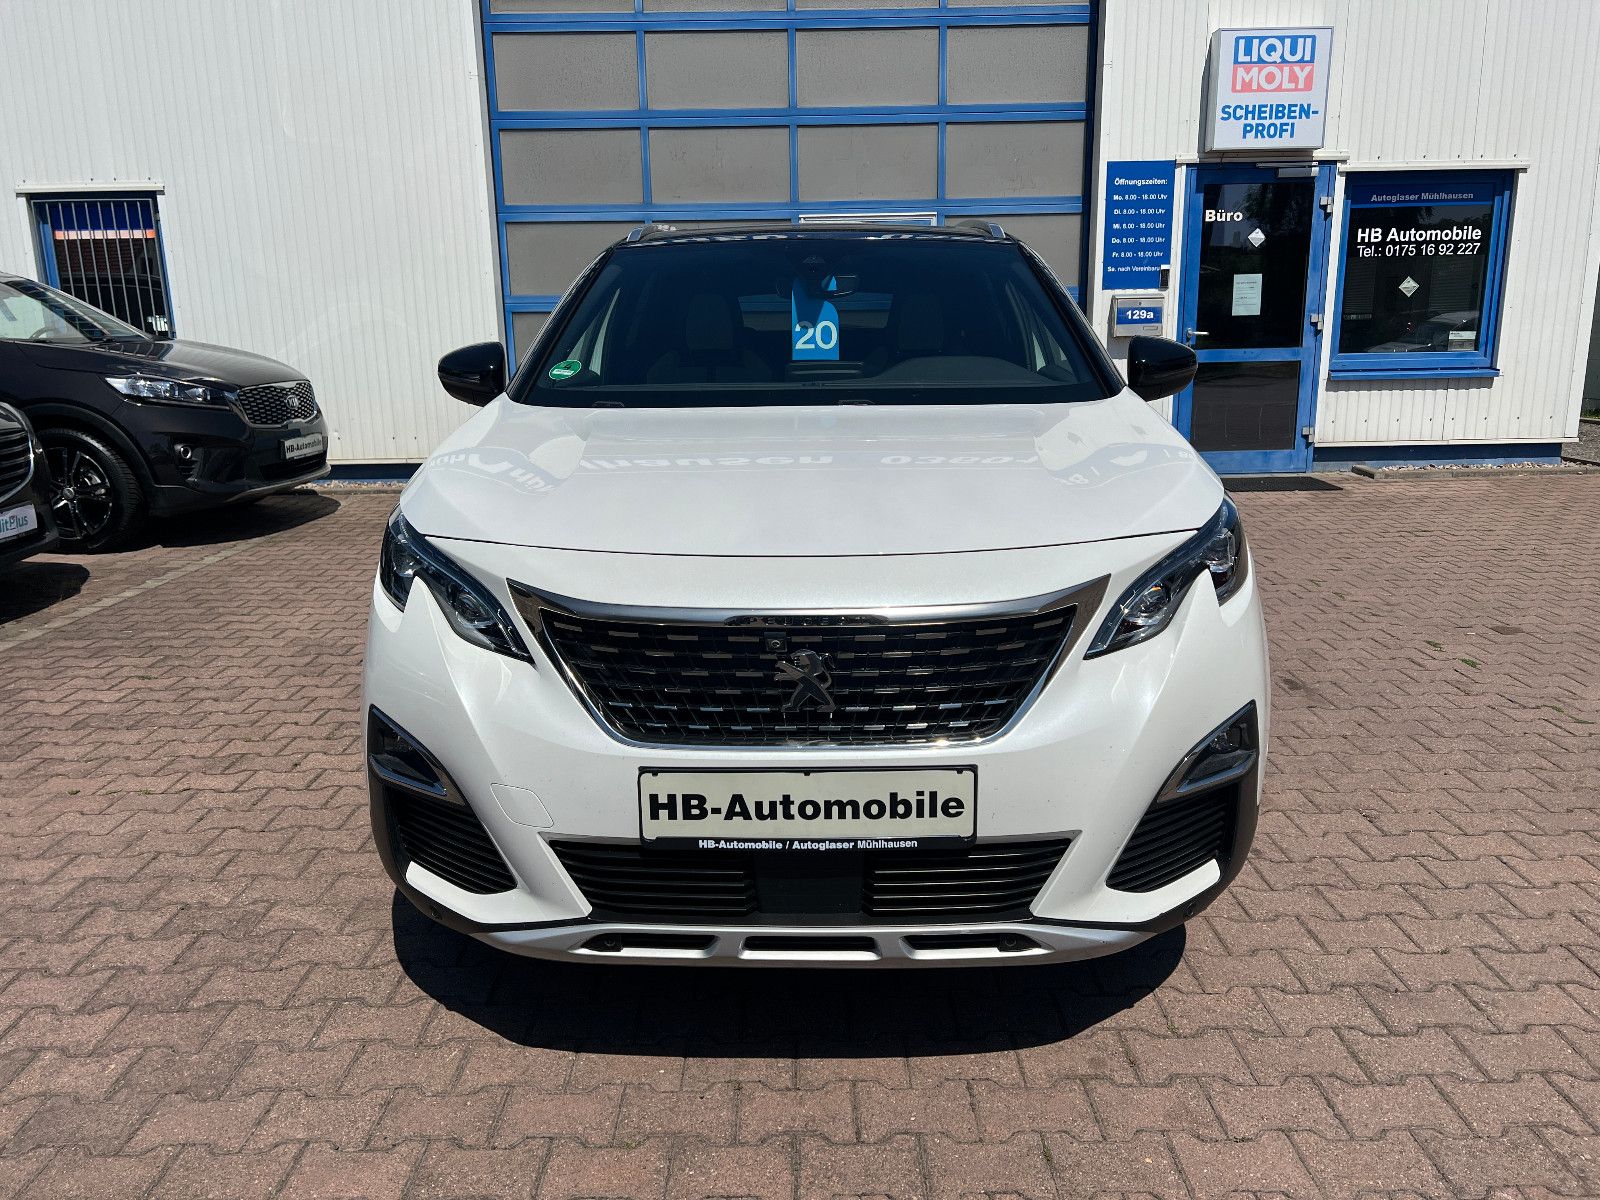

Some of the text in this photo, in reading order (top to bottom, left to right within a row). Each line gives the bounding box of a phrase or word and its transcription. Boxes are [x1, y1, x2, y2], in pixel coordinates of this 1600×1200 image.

[1237, 37, 1312, 63] LIQUI
[1235, 66, 1312, 91] MOLY
[1220, 103, 1319, 121] SCHEIBEN-
[1242, 122, 1296, 139] PROFI
[1114, 177, 1168, 187] Öffnungszeiten:
[1370, 192, 1474, 202] Autoglaser Mühlhausen
[1205, 209, 1243, 222] Büro
[1357, 225, 1482, 243] HB Automobile
[1357, 242, 1481, 258] Tel.: 0175 16 92 227
[1126, 309, 1154, 320] 129a
[795, 320, 838, 350] 20
[648, 790, 966, 821] HB-Automobile
[698, 839, 783, 850] HB-Automobile
[792, 840, 855, 852] Autoglaser
[857, 839, 919, 850] Mühlhausen
